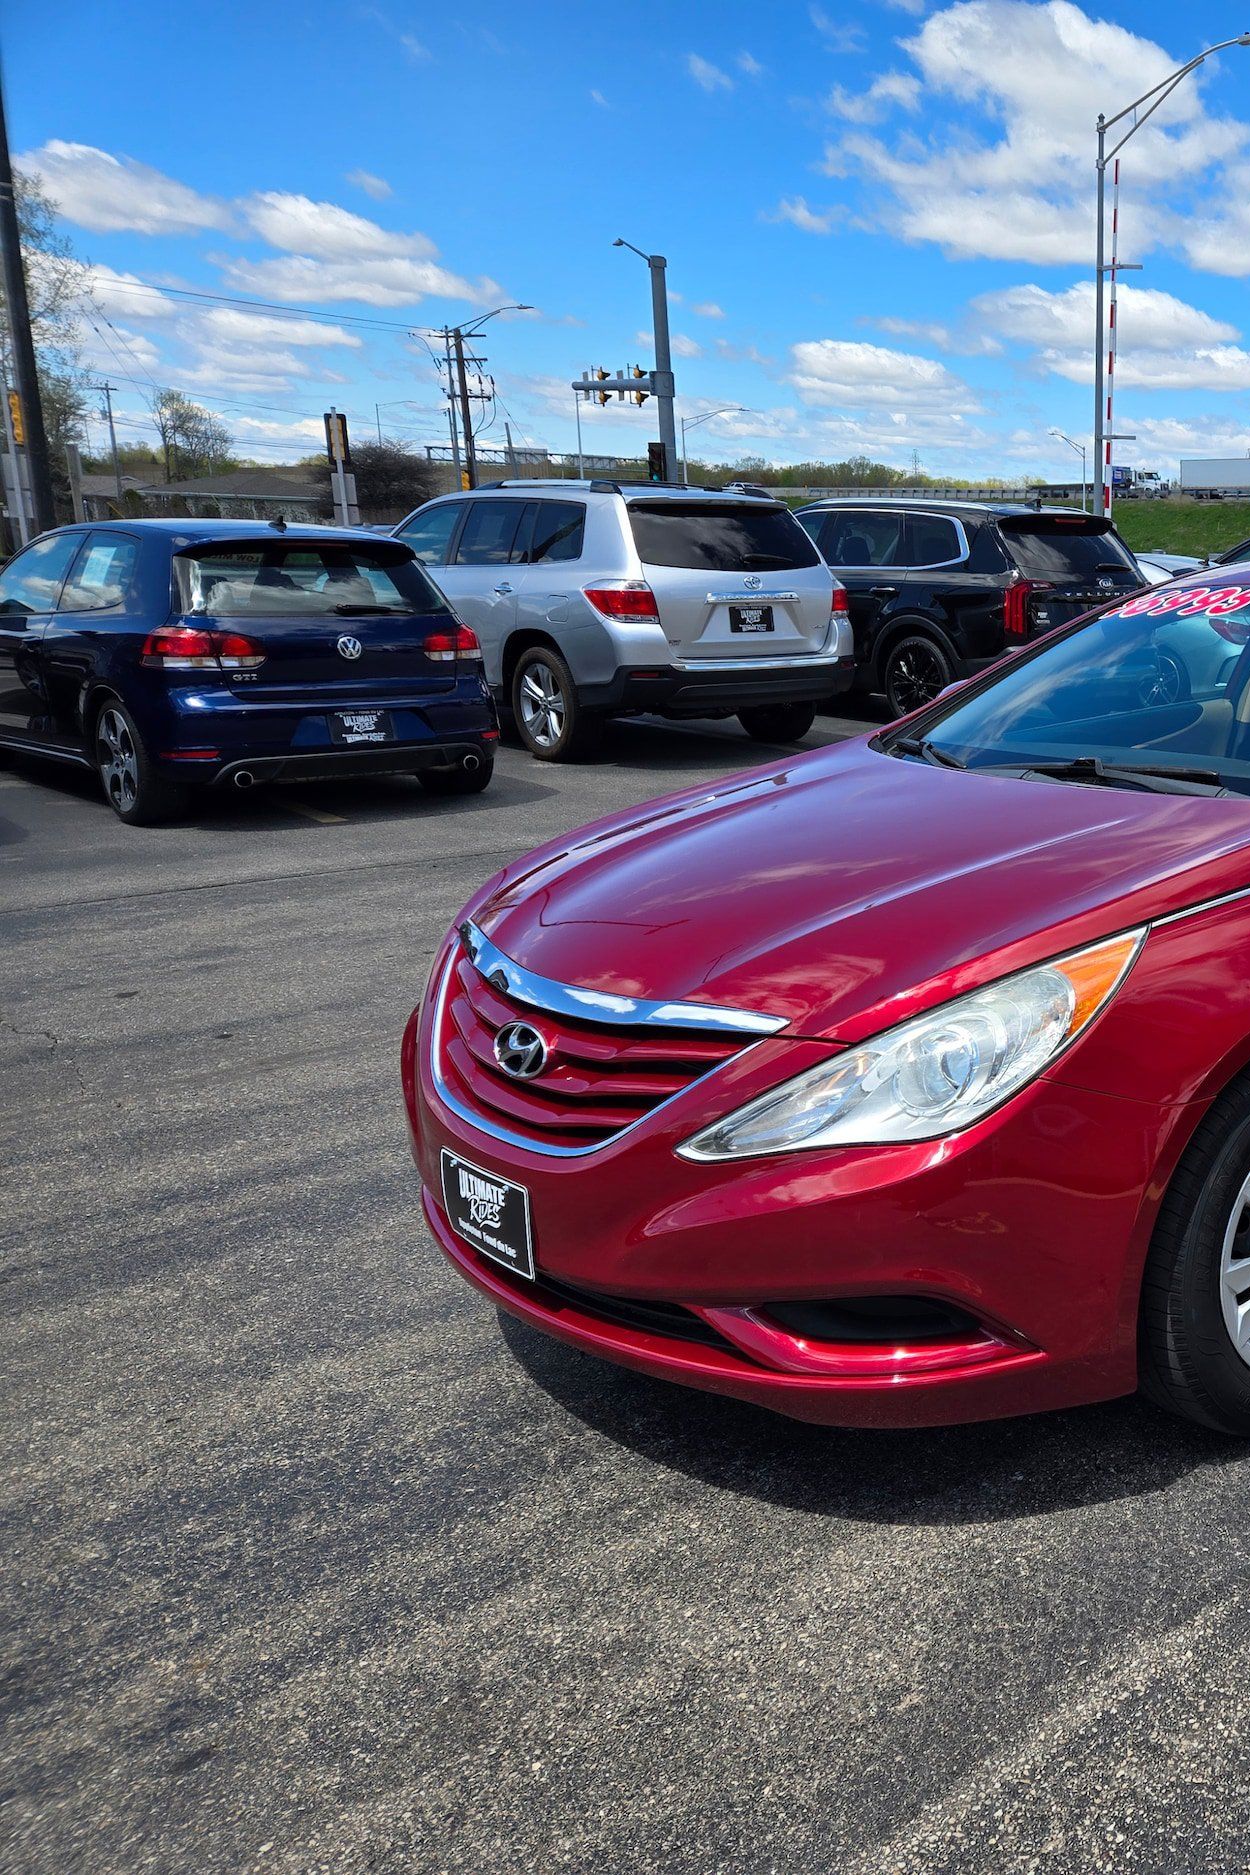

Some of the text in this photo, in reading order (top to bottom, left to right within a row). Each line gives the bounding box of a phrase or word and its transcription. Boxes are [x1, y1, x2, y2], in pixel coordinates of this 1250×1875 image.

[232, 673, 258, 681] GTI
[343, 714, 379, 727] ULTIMATE
[458, 1168, 506, 1207] ULTIMATE
